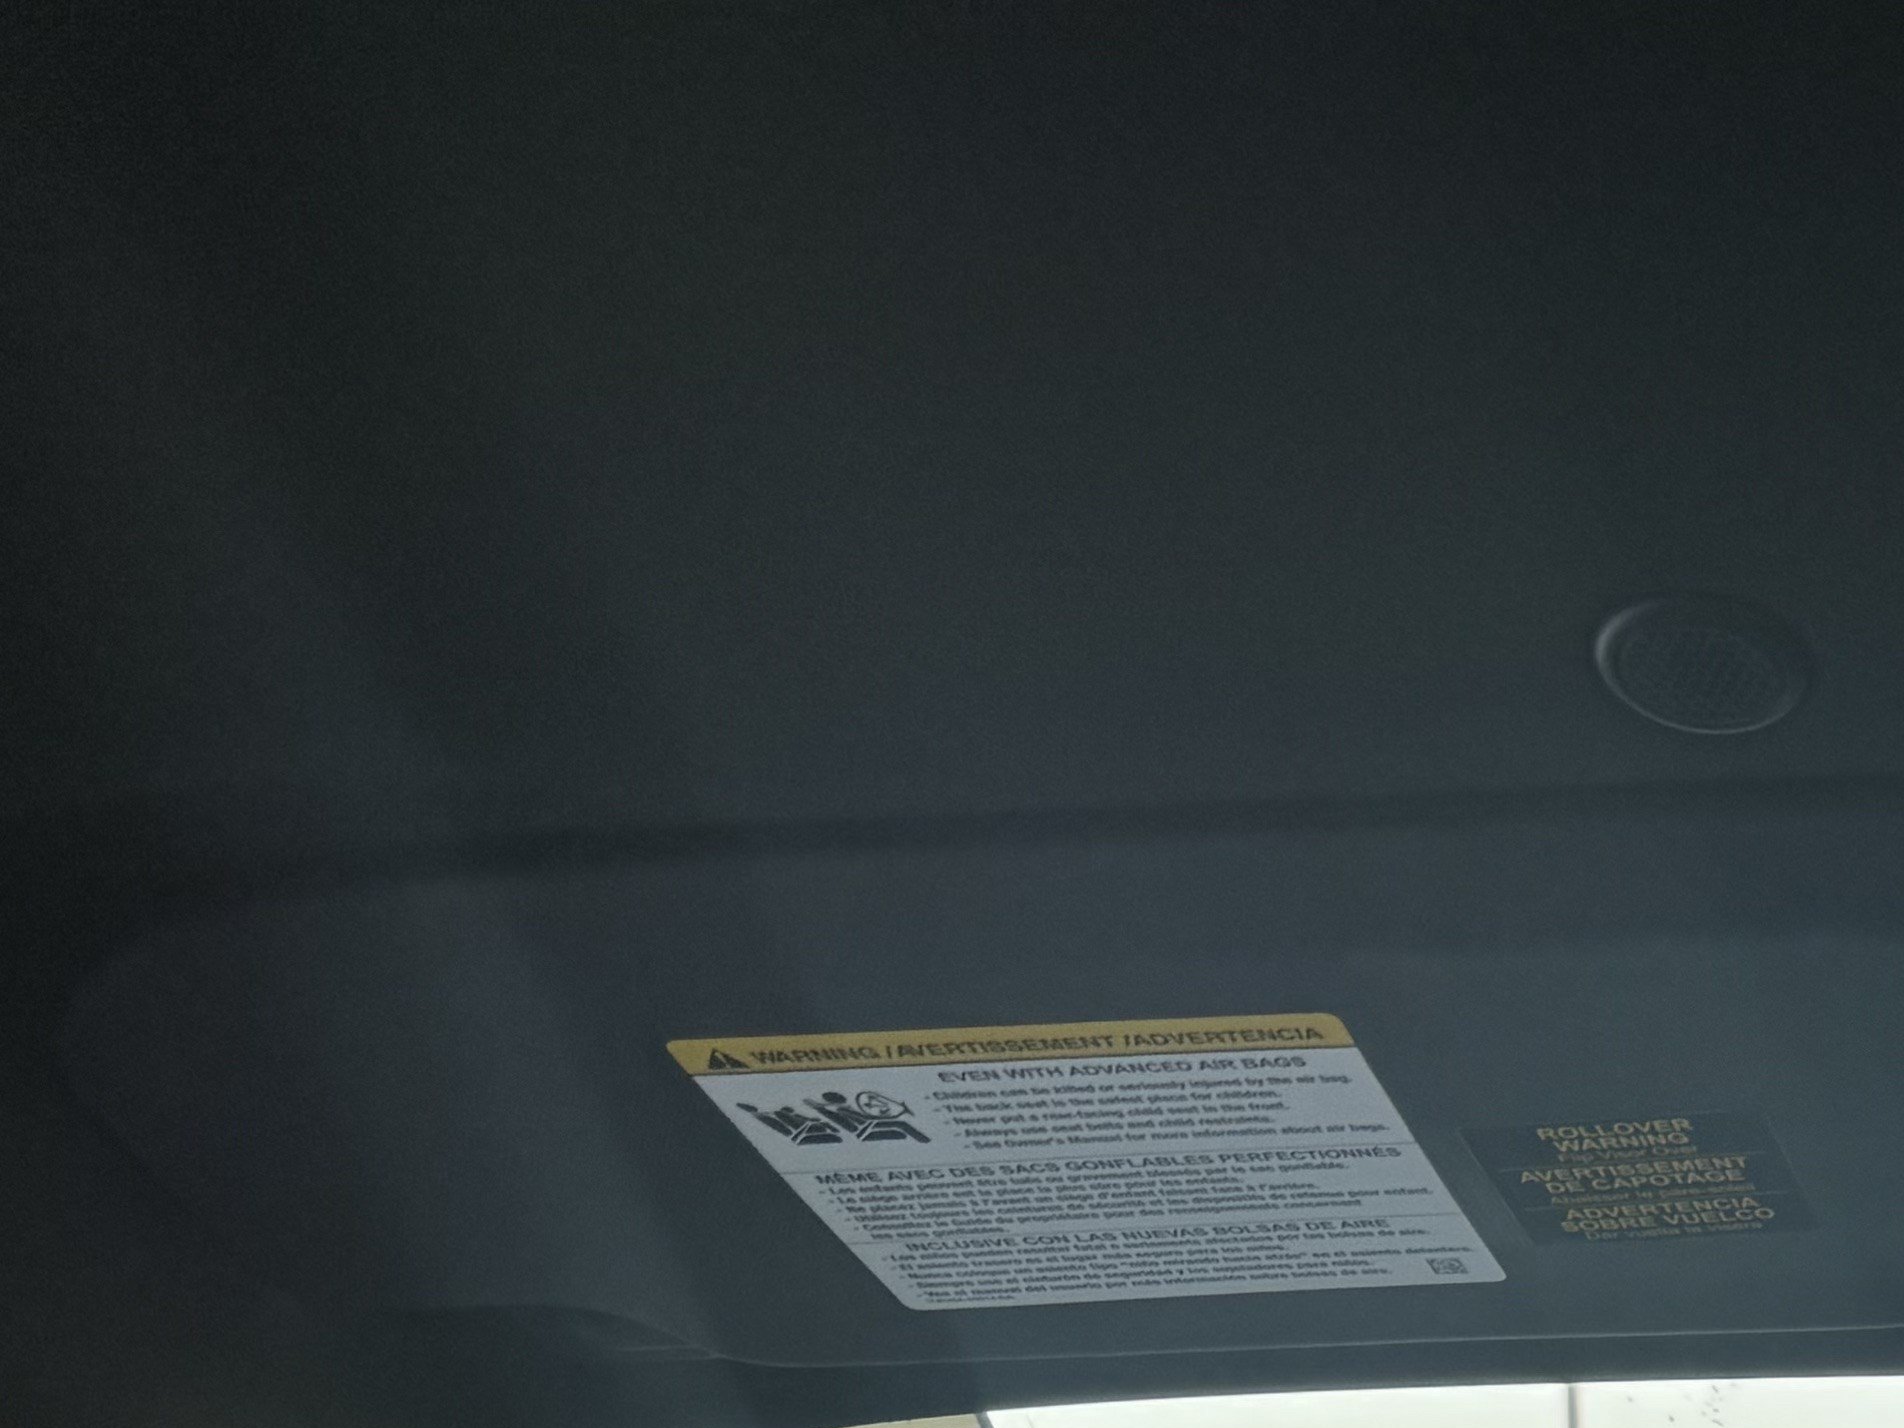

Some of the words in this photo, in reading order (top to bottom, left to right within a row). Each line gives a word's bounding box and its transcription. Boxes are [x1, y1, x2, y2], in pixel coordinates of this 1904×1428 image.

[751, 1045, 881, 1065] WARNING
[938, 1068, 1000, 1082] EVEN
[1003, 1066, 1063, 1080] WITH
[1069, 1060, 1192, 1077] ADVANCED
[1199, 1058, 1236, 1071] AIR
[1241, 1055, 1308, 1070] BAGS
[1537, 1117, 1694, 1141] ROLLOVER
[1553, 1132, 1690, 1152] WARNING
[815, 1171, 884, 1185] MÊME
[889, 1168, 945, 1181] AVEC
[949, 1165, 996, 1179] DES
[999, 1161, 1060, 1177] SACS
[1065, 1154, 1215, 1172] GONFLABLES
[1217, 1146, 1402, 1164] PERFECTIONNÉS
[1591, 1168, 1746, 1190] CAPOTAGE
[1561, 1215, 1657, 1233] SOBRE
[1663, 1207, 1776, 1226] VUELCO
[1566, 1196, 1762, 1220] ADVERTENCIA
[905, 1236, 1019, 1252] INCLUSIVE
[1022, 1234, 1071, 1248] CON
[1075, 1230, 1118, 1245] LAS
[1122, 1225, 1214, 1242] NUEVAS
[1216, 1222, 1302, 1237] BOLSAS
[1305, 1219, 1336, 1231] DE
[1340, 1217, 1390, 1230] AIRE
